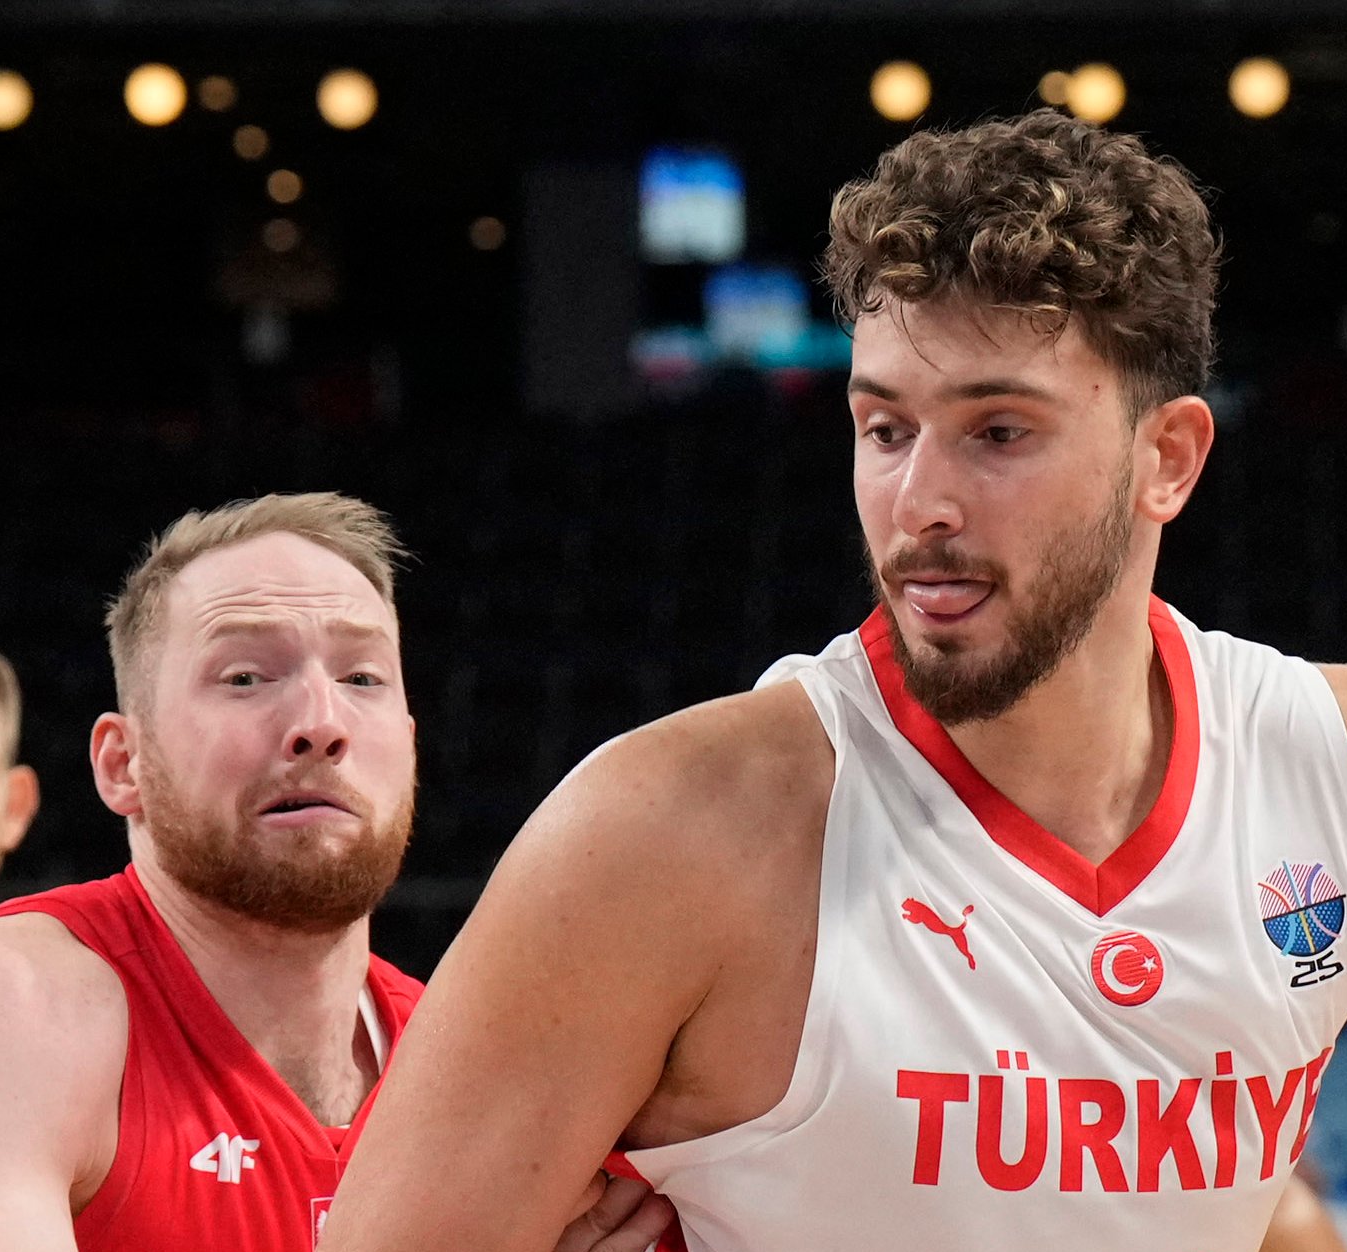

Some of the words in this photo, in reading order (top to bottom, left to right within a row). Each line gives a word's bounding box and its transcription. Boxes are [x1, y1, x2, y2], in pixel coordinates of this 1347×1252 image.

[1290, 950, 1344, 988] 25
[896, 1046, 1333, 1193] TÜRKİYE
[189, 1132, 260, 1184] 4F
